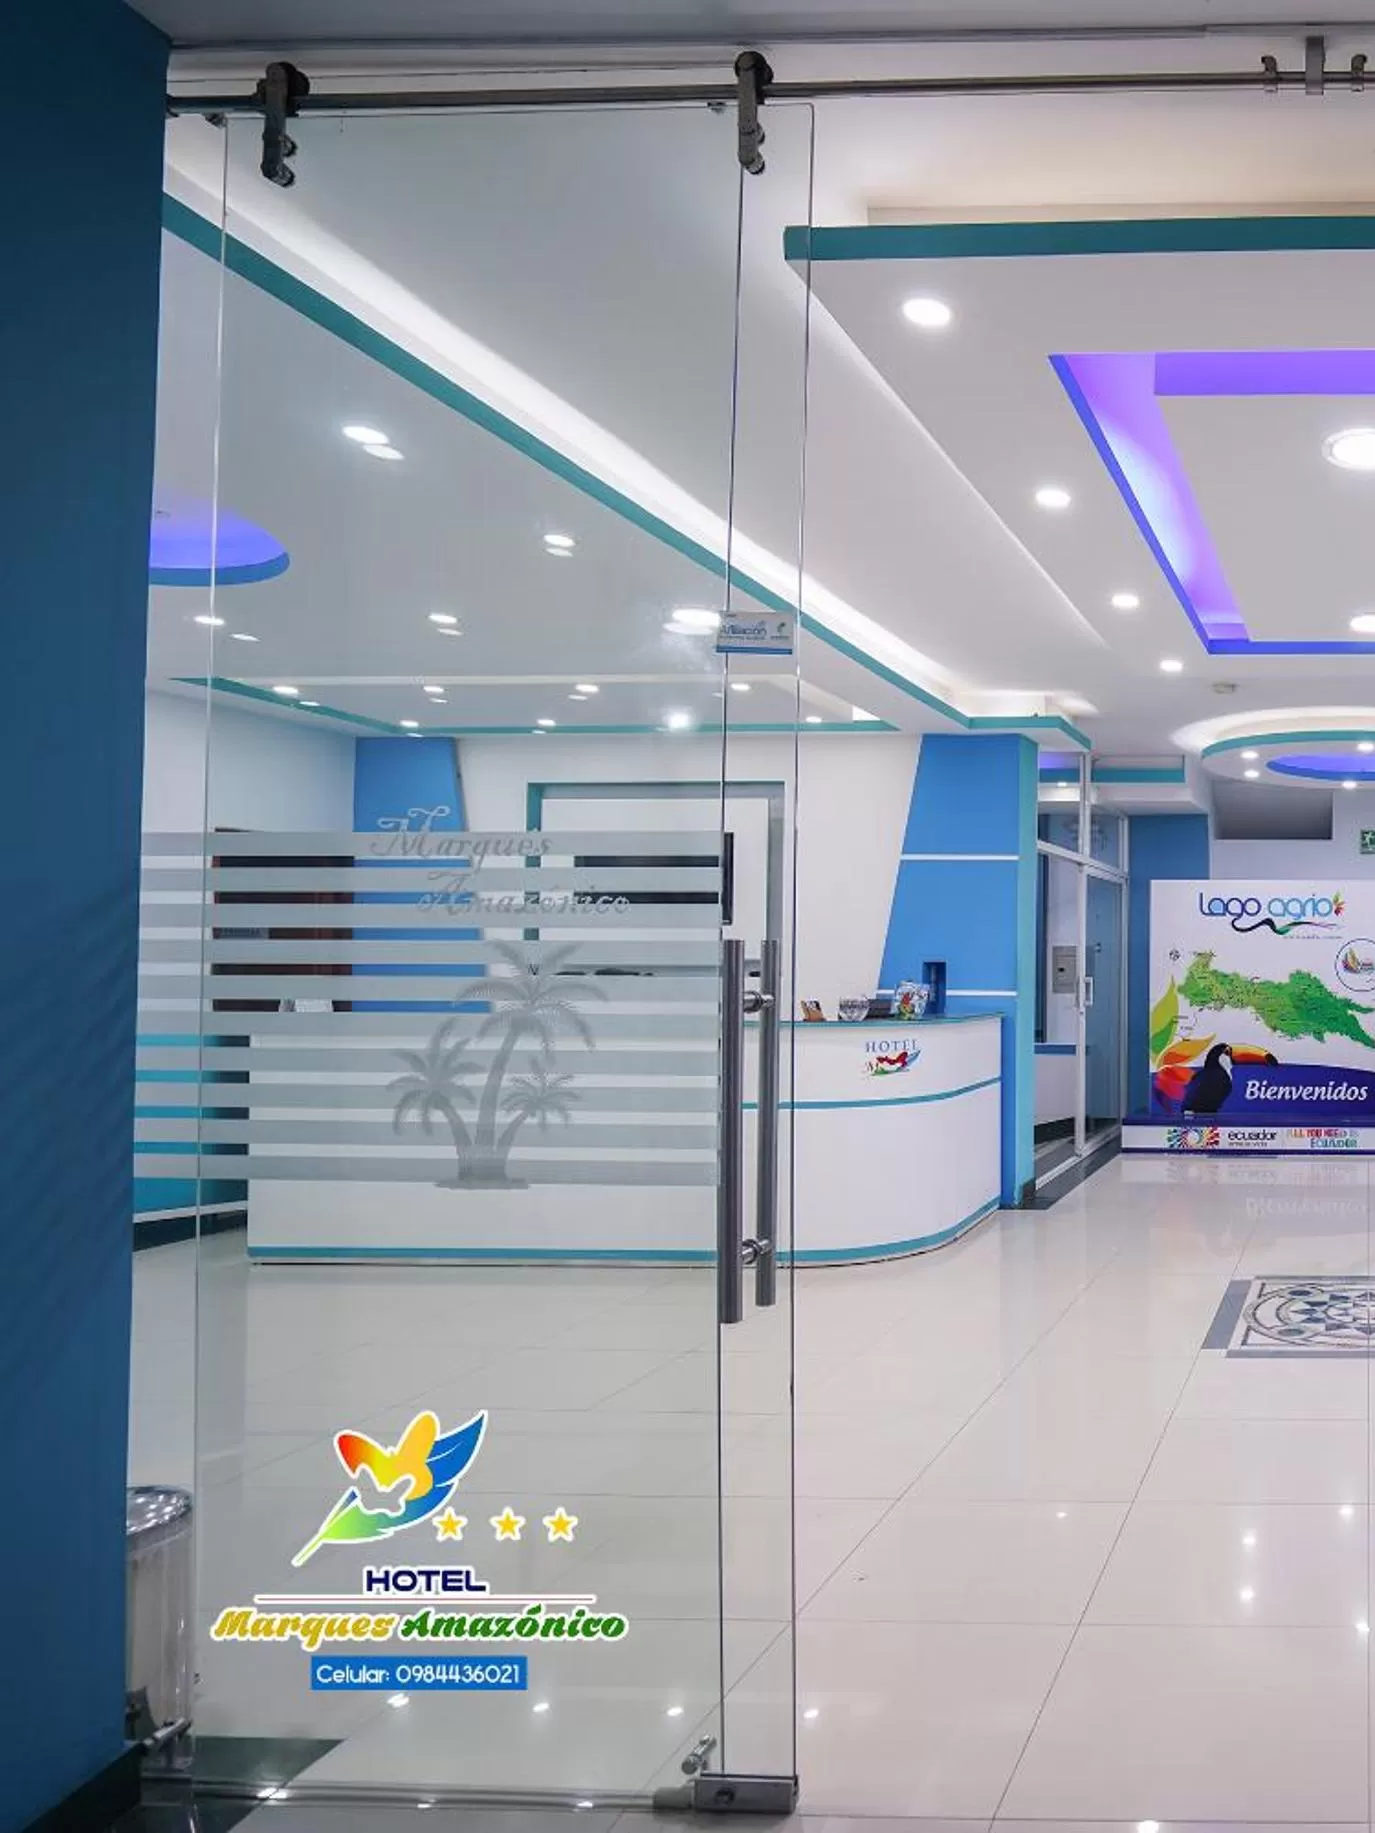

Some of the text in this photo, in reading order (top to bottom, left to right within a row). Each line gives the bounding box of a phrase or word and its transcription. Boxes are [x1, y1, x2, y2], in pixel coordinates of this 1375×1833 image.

[866, 1039, 919, 1053] HOTEL
[1245, 1079, 1368, 1101] Bienvenidos
[1228, 1129, 1277, 1141] ecuador
